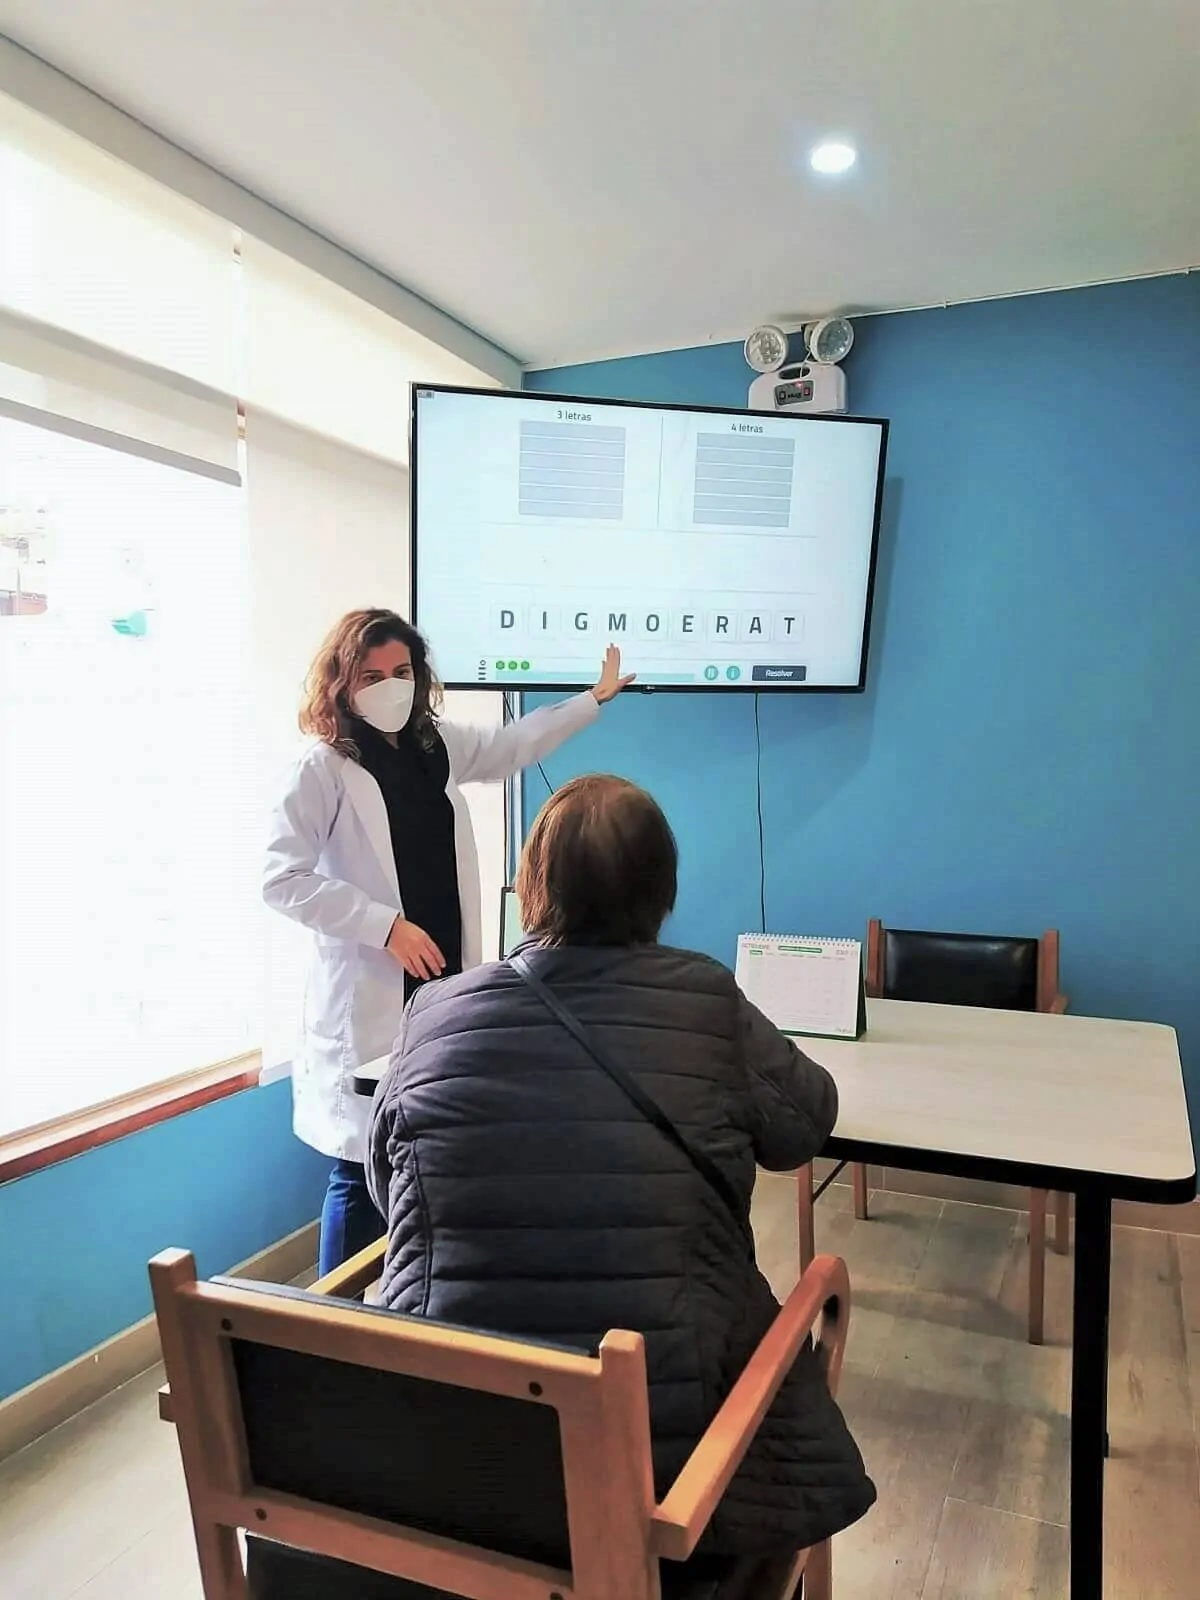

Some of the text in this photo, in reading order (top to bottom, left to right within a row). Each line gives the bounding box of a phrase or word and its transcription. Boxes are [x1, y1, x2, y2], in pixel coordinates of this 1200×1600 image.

[557, 409, 592, 421] 3 letras
[731, 423, 764, 433] 4 letras
[765, 668, 794, 678] Resolver
